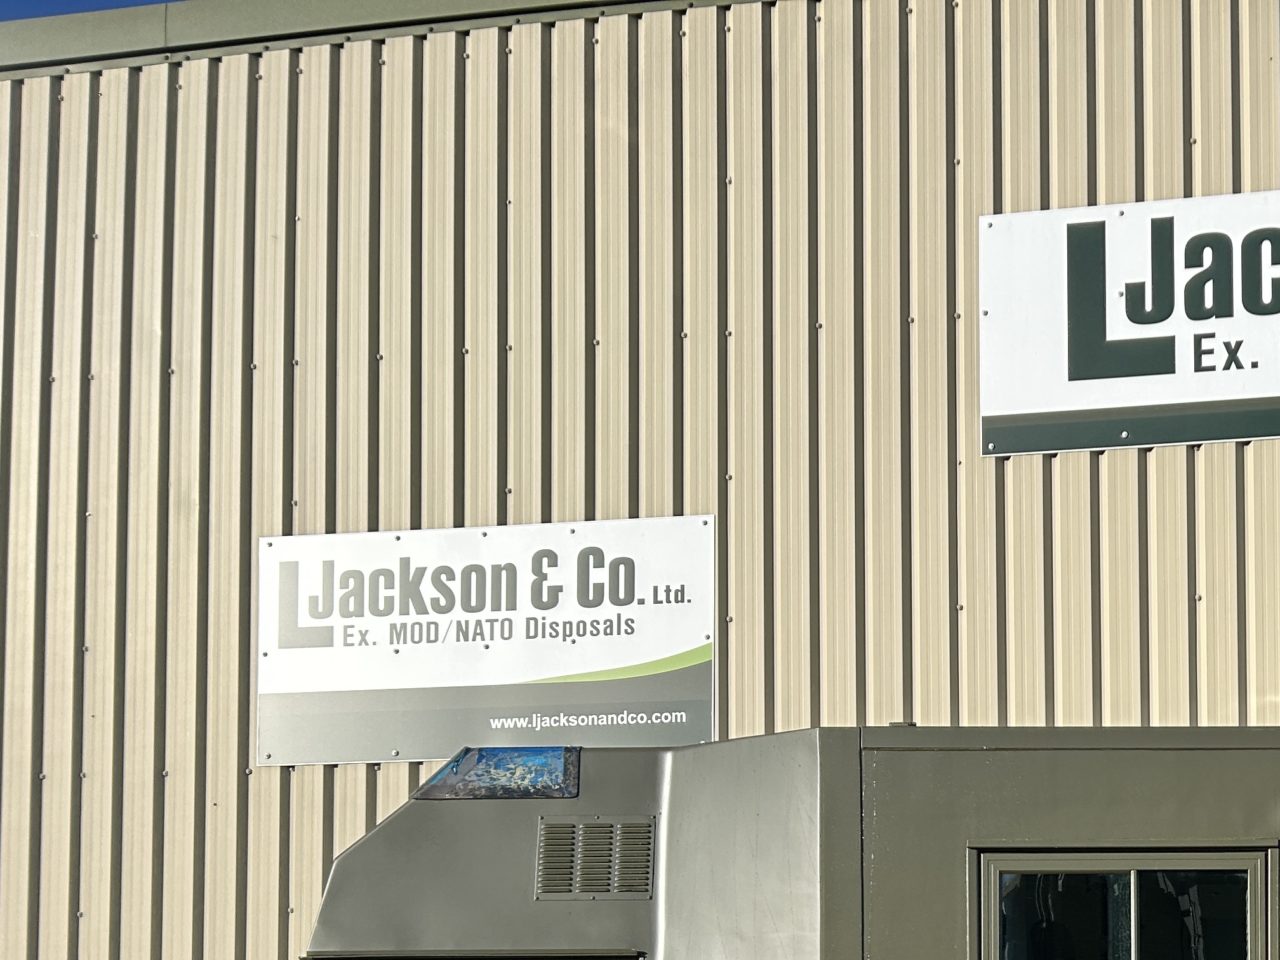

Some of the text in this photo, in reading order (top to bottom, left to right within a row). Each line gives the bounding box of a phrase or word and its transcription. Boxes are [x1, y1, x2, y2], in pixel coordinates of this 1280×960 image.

[1193, 332, 1259, 373] Ex.
[530, 548, 564, 611] &
[576, 546, 646, 609] Co.
[652, 584, 692, 605] Ltd.
[343, 612, 636, 647] Ex. MOD/NATO Disposals
[489, 711, 687, 732] www.ljacksonandco.com
